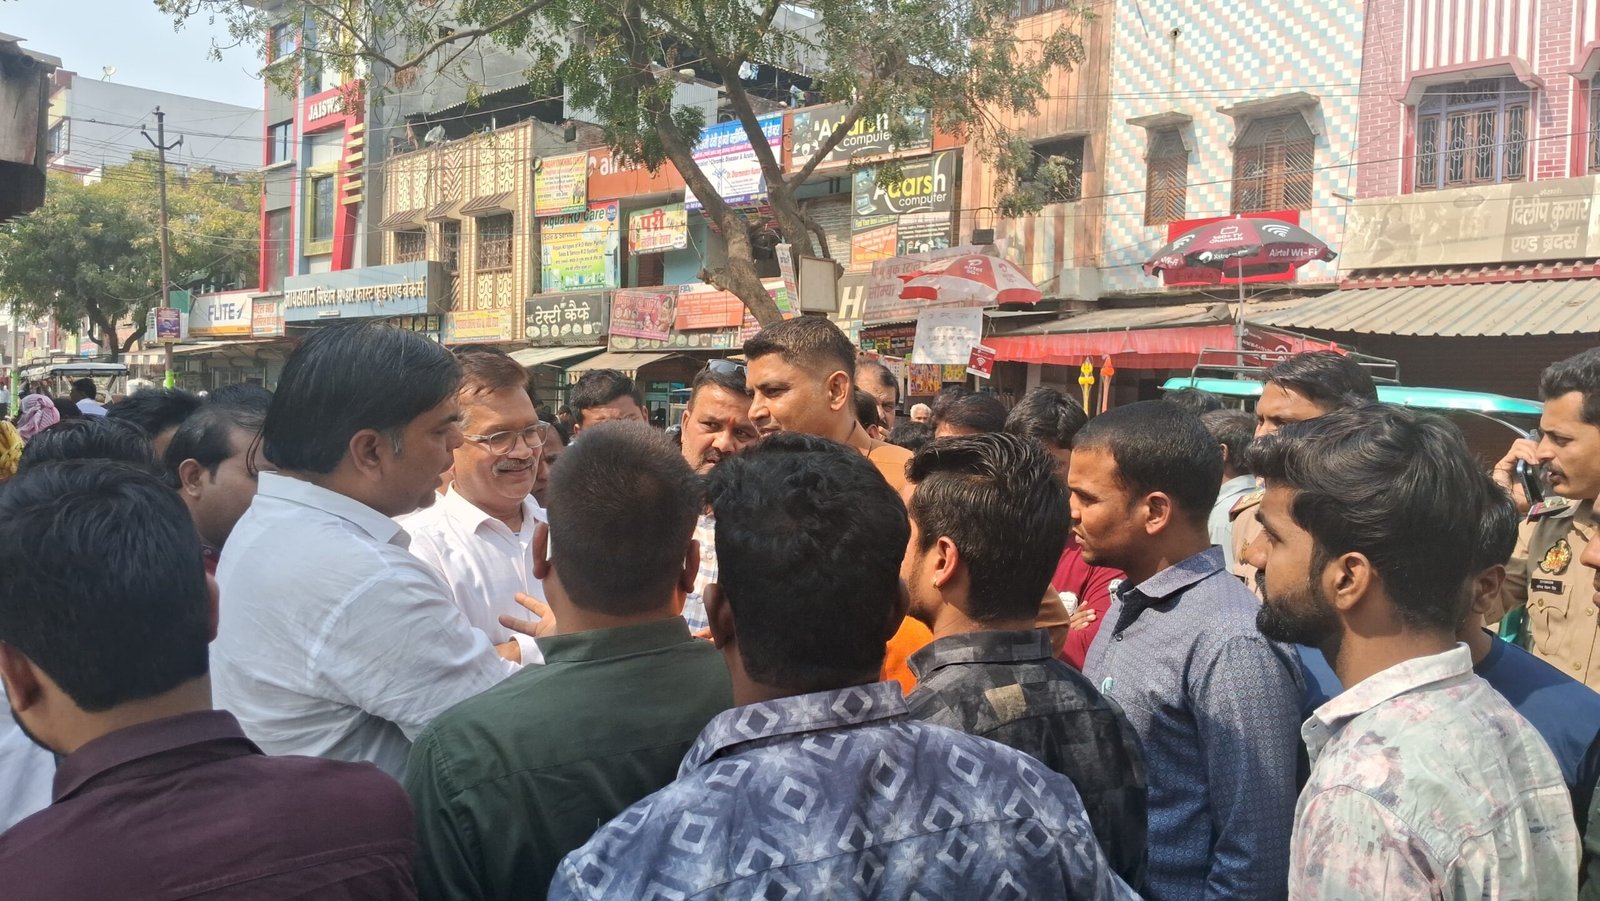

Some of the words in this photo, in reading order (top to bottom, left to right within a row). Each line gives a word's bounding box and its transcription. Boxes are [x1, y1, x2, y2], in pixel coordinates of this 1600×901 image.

[898, 192, 947, 208] computer
[543, 214, 566, 230] Aqua
[584, 208, 605, 221] Care
[640, 208, 666, 232] परी
[1510, 194, 1550, 226] दिलीप
[1550, 198, 1591, 233] कुमार
[1511, 235, 1541, 254] एण्ड
[1542, 226, 1581, 254] ब्रदर्स
[1269, 248, 1290, 257] Airtel
[1291, 247, 1318, 257] Wi-Fi
[284, 287, 317, 309] जायसवाल
[355, 286, 375, 302] फास्ट
[838, 286, 868, 319] H
[208, 302, 236, 321] FLITE
[535, 304, 561, 325] टेस्टी
[564, 299, 591, 322] कैफे
